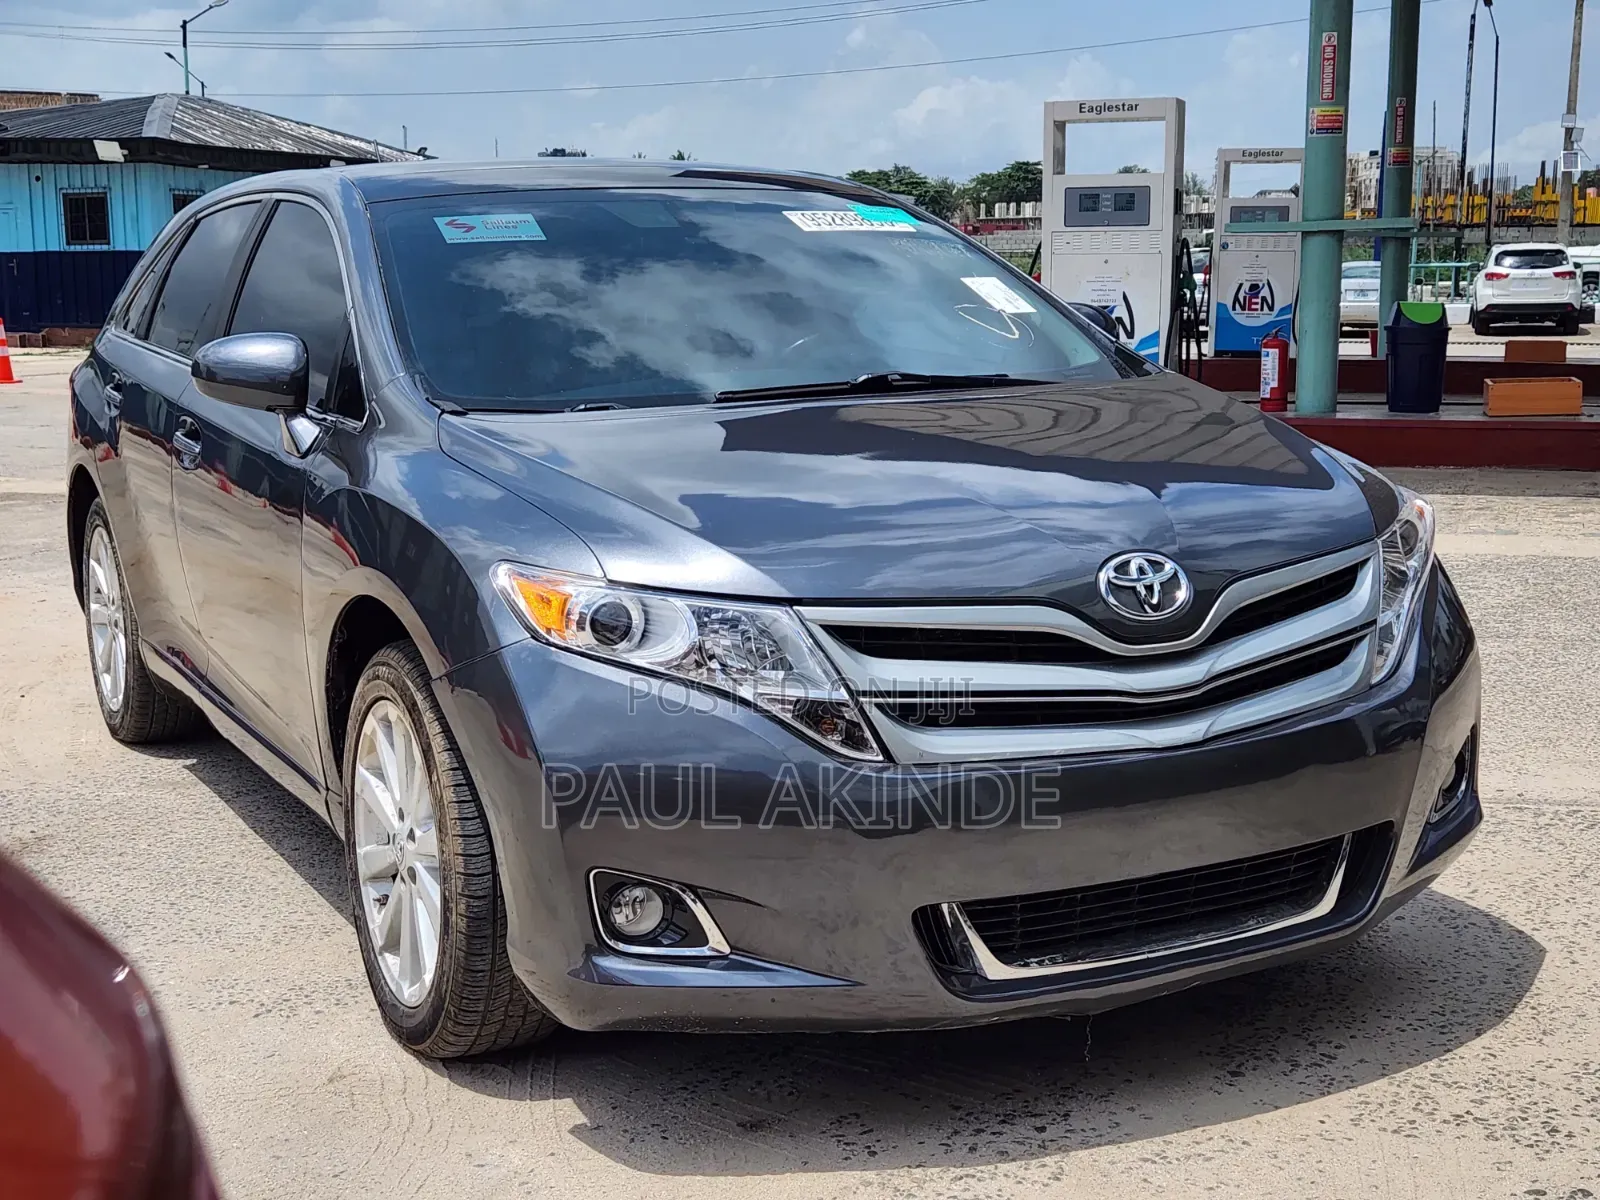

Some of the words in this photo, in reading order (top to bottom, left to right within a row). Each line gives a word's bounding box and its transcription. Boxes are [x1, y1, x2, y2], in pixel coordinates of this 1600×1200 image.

[1324, 46, 1334, 57] NO
[1322, 60, 1334, 99] SMOKING
[1078, 102, 1140, 115] Eaglestar
[1396, 116, 1404, 143] SMOKING
[1242, 150, 1284, 158] Eaglestar
[1232, 278, 1275, 312] NEN
